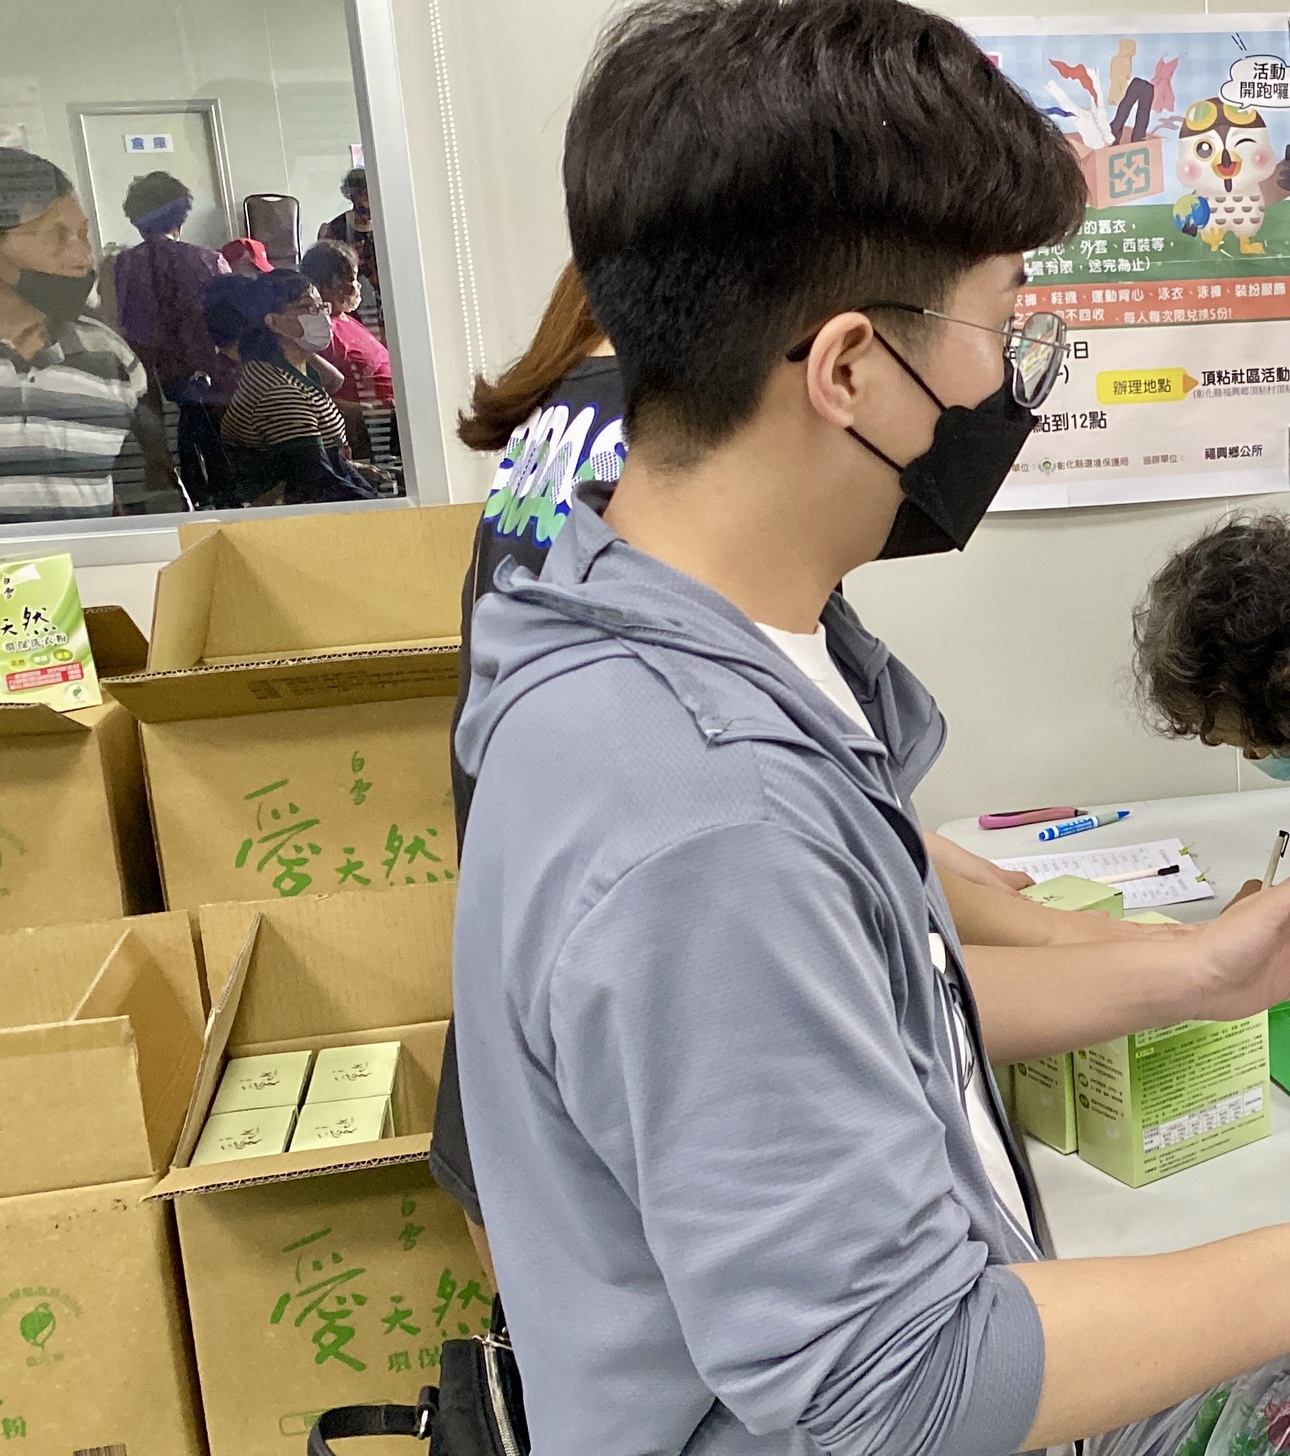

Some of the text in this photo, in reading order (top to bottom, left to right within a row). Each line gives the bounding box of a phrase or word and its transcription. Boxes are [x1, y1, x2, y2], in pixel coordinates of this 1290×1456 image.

[1253, 62, 1286, 81] 活動
[1113, 378, 1172, 395] 辦理地點
[1204, 444, 1263, 460] 福興鄉公所
